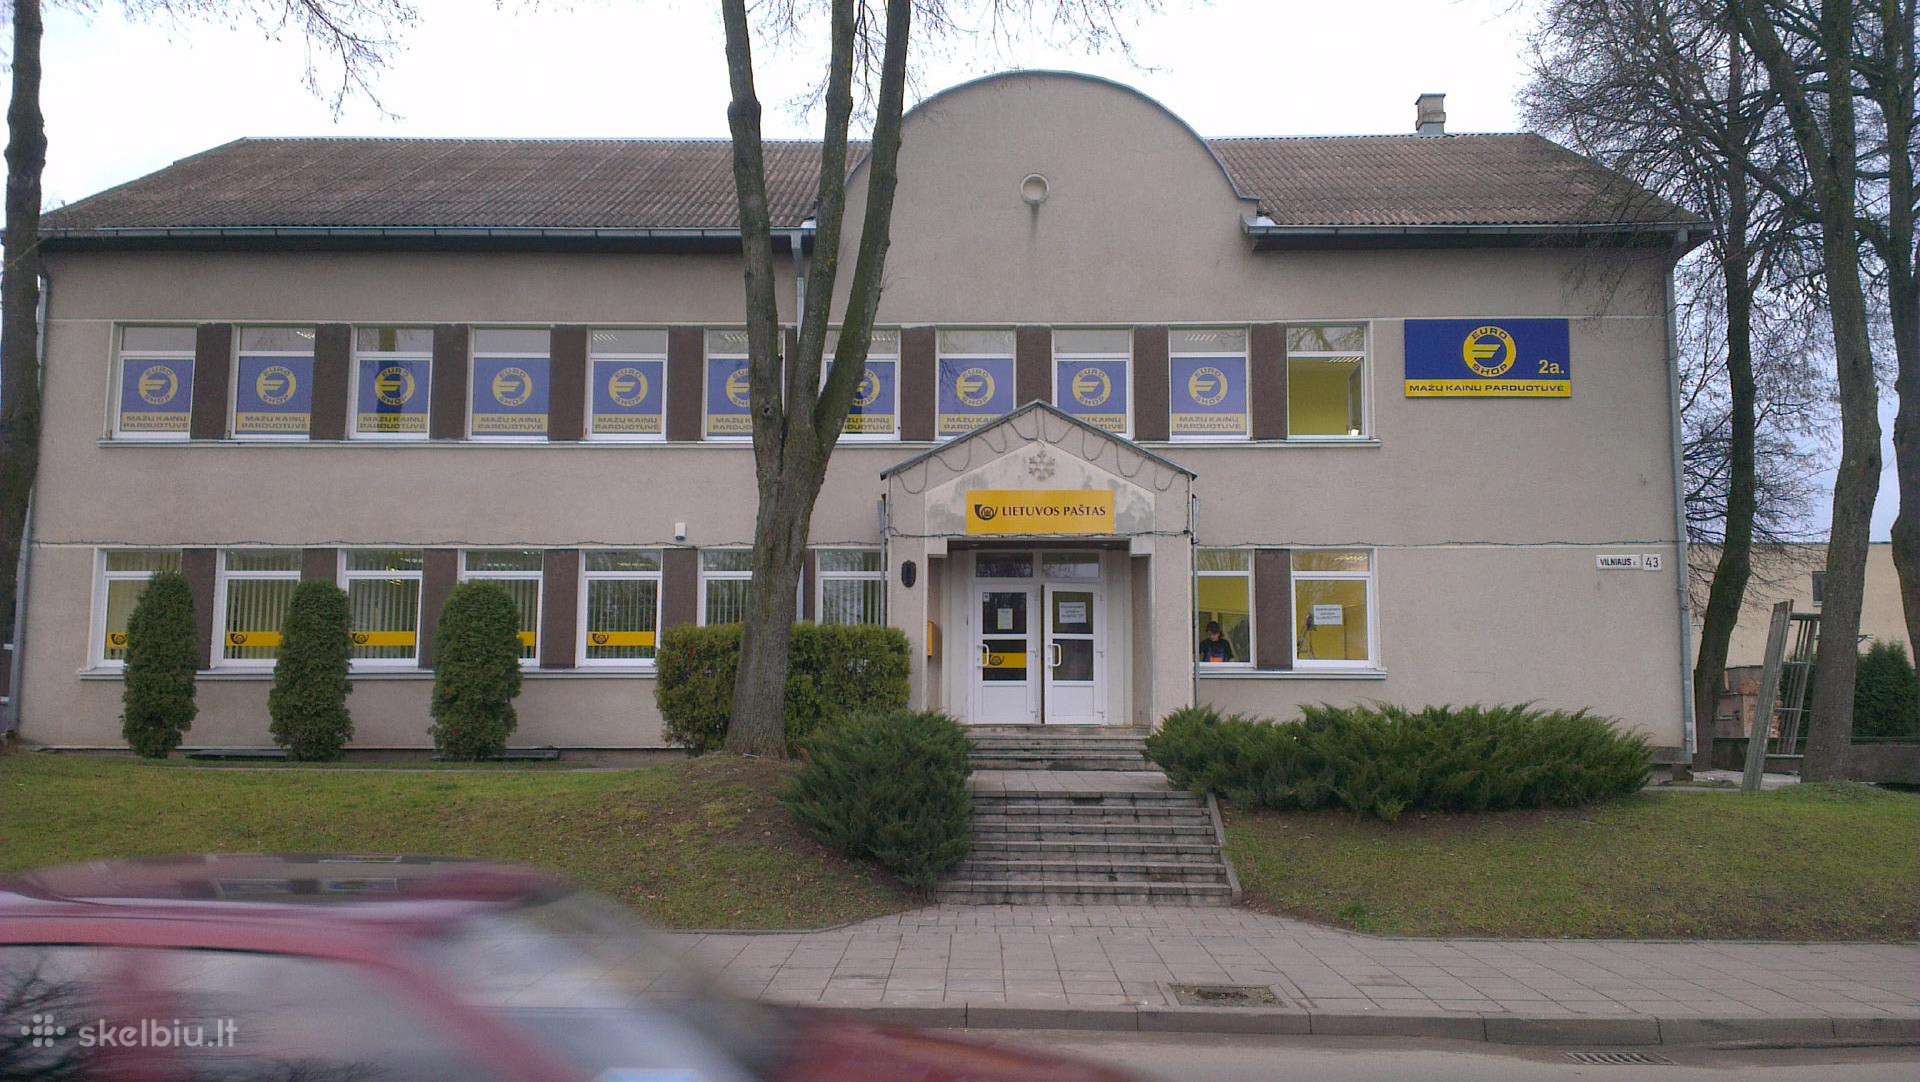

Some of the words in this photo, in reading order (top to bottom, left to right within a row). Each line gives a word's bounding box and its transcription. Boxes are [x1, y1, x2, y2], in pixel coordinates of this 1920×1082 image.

[1471, 327, 1508, 341] EURO
[382, 367, 408, 377] EURO
[1472, 363, 1508, 376] SHOP
[1538, 359, 1565, 375] 2a.
[1002, 506, 1060, 517] LIETUVOS
[1063, 504, 1106, 517] PAŠTAS
[1600, 558, 1632, 566] VILNIAUS
[1645, 557, 1659, 568] 43
